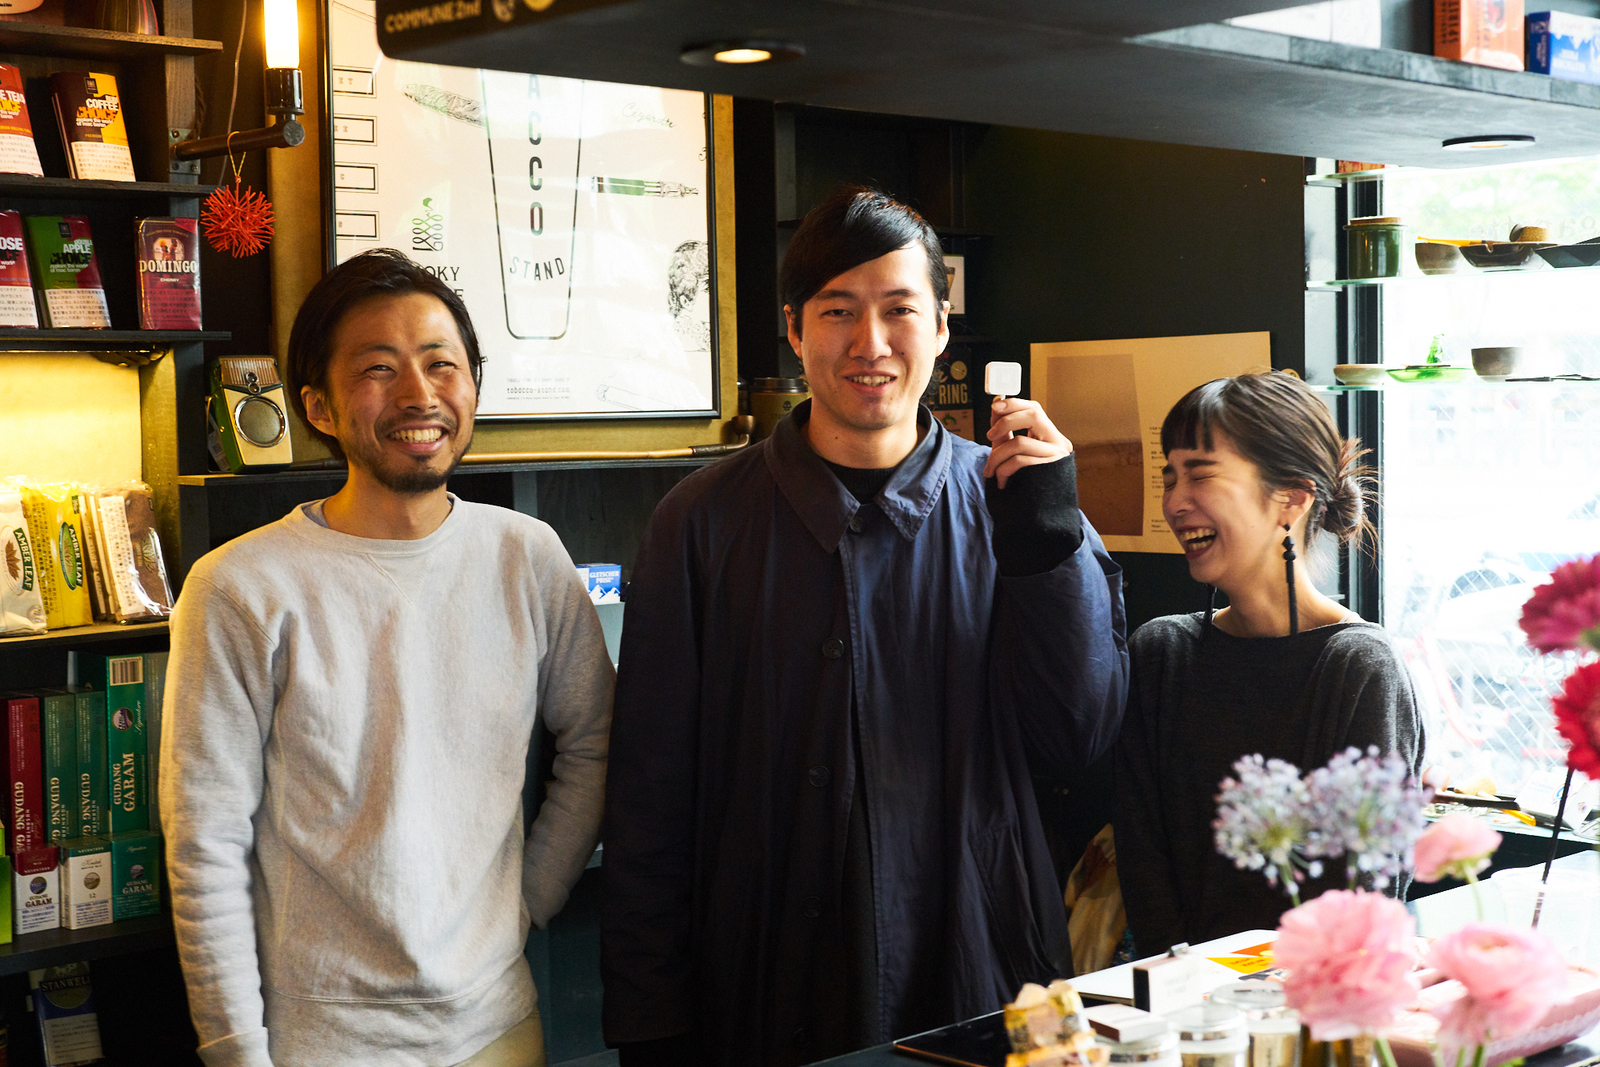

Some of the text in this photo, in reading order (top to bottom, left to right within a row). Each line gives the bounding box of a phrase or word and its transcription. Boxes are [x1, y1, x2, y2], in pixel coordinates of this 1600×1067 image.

[384, 2, 454, 34] COMMUNE
[76, 106, 118, 121] CHOICE
[86, 98, 120, 112] COFFEE
[50, 252, 91, 265] CHOICE
[63, 243, 92, 254] APPLE
[138, 260, 199, 273] DOMINGO
[509, 256, 565, 282] STAND
[939, 383, 968, 405] RING
[68, 527, 81, 559] AMBER
[14, 530, 33, 590] AMBER LEAF
[112, 763, 122, 806] GUDANG
[122, 752, 135, 812] GARAM
[14, 781, 25, 830] GUDANG
[50, 777, 60, 825] GUDANG
[81, 773, 91, 821] GUDANG
[122, 884, 152, 895] GARAM
[25, 898, 52, 908] GARAM
